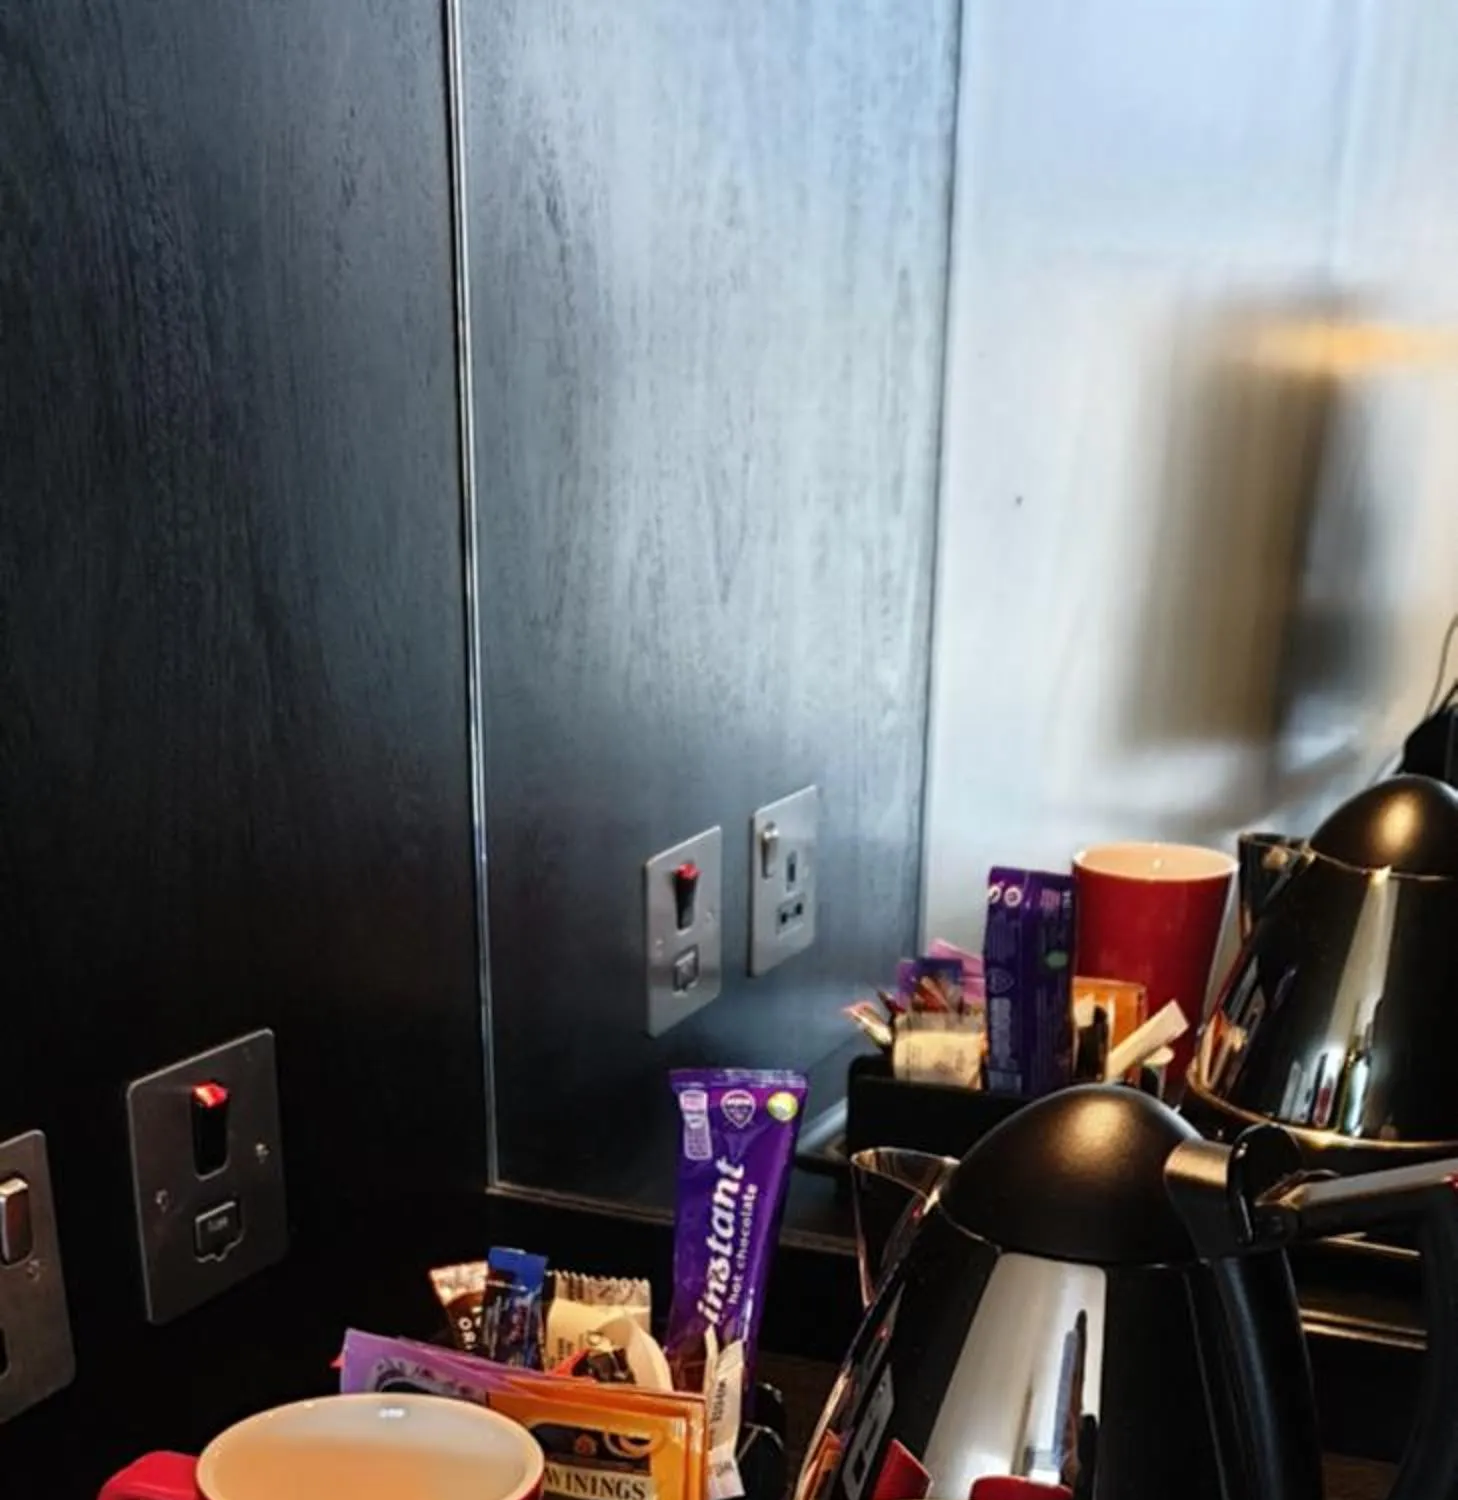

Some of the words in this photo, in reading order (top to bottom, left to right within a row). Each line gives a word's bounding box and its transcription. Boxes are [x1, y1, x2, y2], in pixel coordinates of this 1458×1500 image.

[697, 1156, 745, 1324] instant
[728, 1273, 744, 1305] hot
[736, 1183, 759, 1270] chocolate
